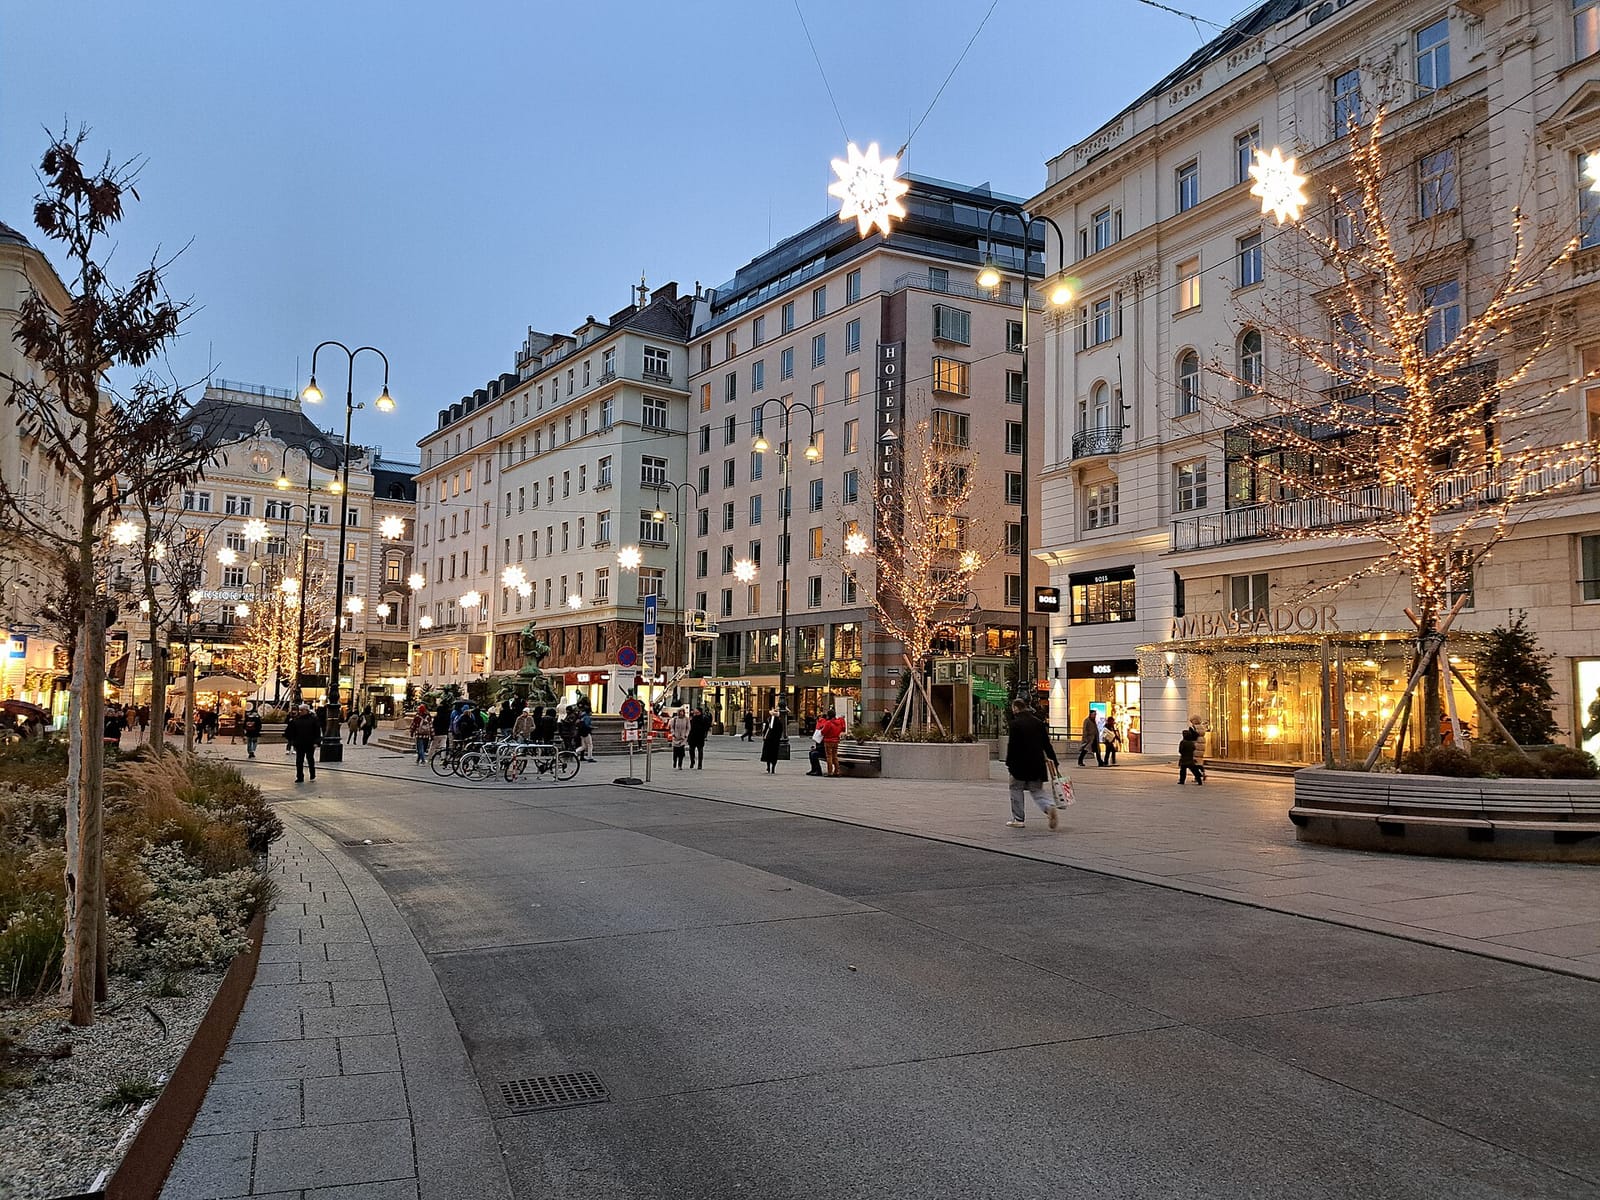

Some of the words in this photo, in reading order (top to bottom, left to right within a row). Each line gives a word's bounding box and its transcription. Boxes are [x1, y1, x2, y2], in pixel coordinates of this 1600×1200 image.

[884, 347, 896, 424] HOTEL
[882, 445, 894, 526] EUROP
[1094, 575, 1109, 583] BOSS
[1038, 595, 1057, 604] BOSS
[1170, 604, 1341, 639] AMBASSADOR
[955, 663, 963, 677] P
[1092, 665, 1112, 674] BOSS
